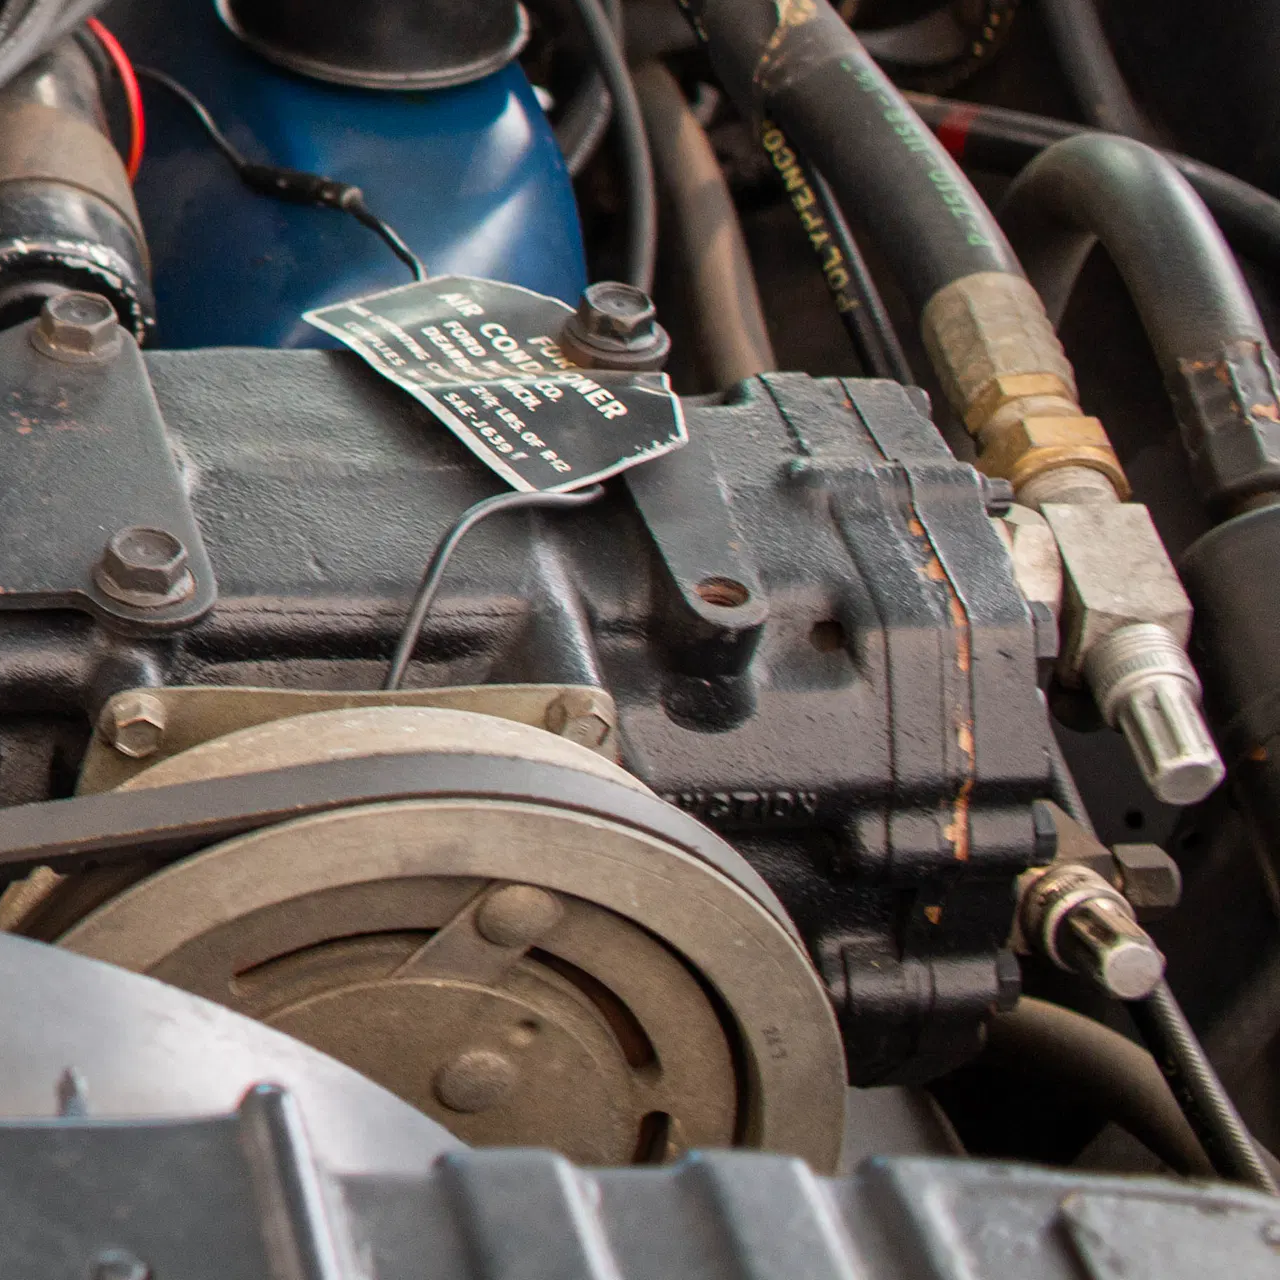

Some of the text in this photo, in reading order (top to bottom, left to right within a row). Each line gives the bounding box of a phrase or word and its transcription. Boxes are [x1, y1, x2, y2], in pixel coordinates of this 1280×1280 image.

[436, 292, 486, 319] AIR
[442, 320, 487, 358] FORD
[520, 430, 547, 448] OF
